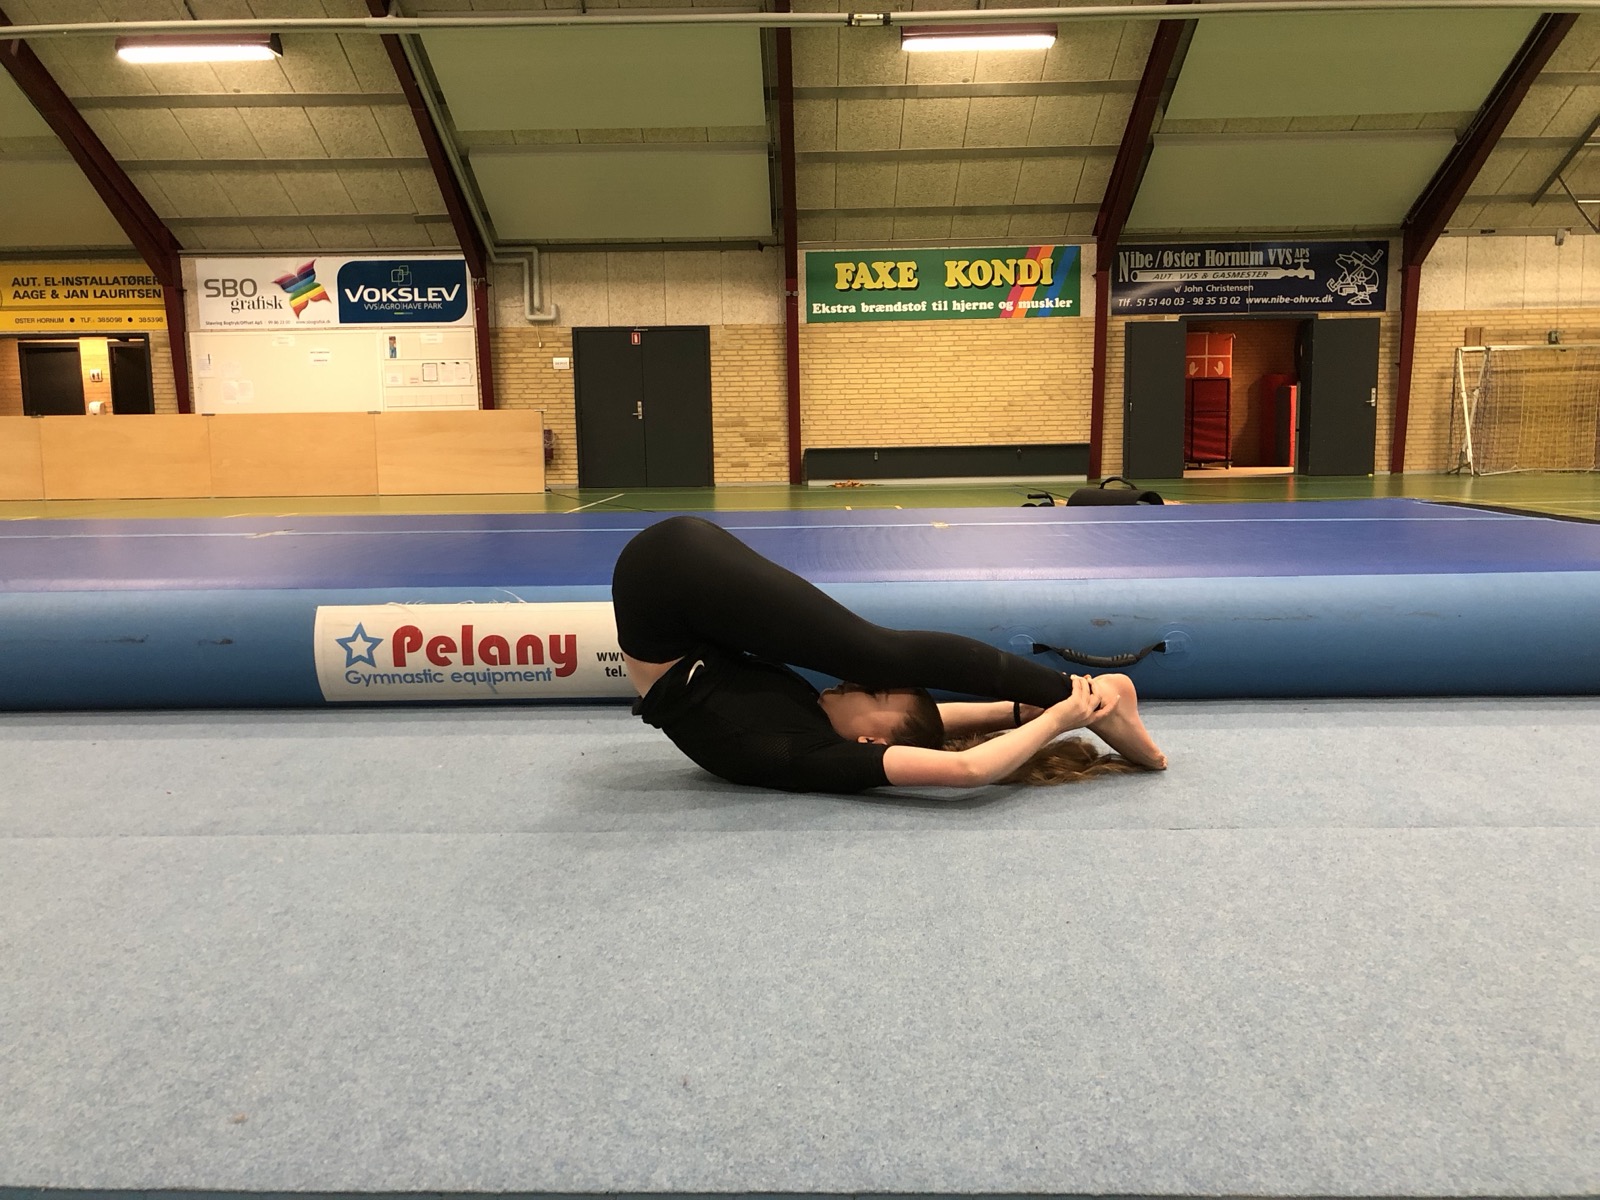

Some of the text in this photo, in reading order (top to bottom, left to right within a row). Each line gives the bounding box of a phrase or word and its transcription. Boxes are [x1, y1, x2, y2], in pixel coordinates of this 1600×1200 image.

[1204, 249, 1264, 267] Hornum
[1267, 248, 1293, 266] VVS
[1294, 248, 1310, 258] APS
[11, 277, 41, 287] AUT.
[835, 257, 1054, 290] FAXE KONDI
[1212, 271, 1269, 280] GASMESTER
[12, 289, 162, 300] AAGE & JAN LAURITSEN
[203, 278, 258, 298] SBO
[344, 284, 461, 303] VOKSLEV
[1183, 284, 1203, 293] John
[1205, 284, 1254, 293] Christensen
[230, 295, 283, 314] grafisk
[812, 297, 1073, 315] Ekstra brændstof til hjerne og muskler
[1118, 298, 1132, 307] Tlf.
[1136, 298, 1146, 306] 51
[1148, 298, 1158, 306] 51
[1160, 297, 1172, 306] 40
[1173, 297, 1185, 306] 03
[1192, 297, 1204, 306] 98
[1205, 297, 1216, 306] 35
[1219, 296, 1228, 305] 13
[1229, 296, 1241, 305] 02
[1245, 294, 1334, 305] www.nibe-ohvvs.dk
[392, 625, 577, 677] Pelany
[345, 667, 553, 689] Gymnastic equipment
[605, 665, 627, 677] tel.
